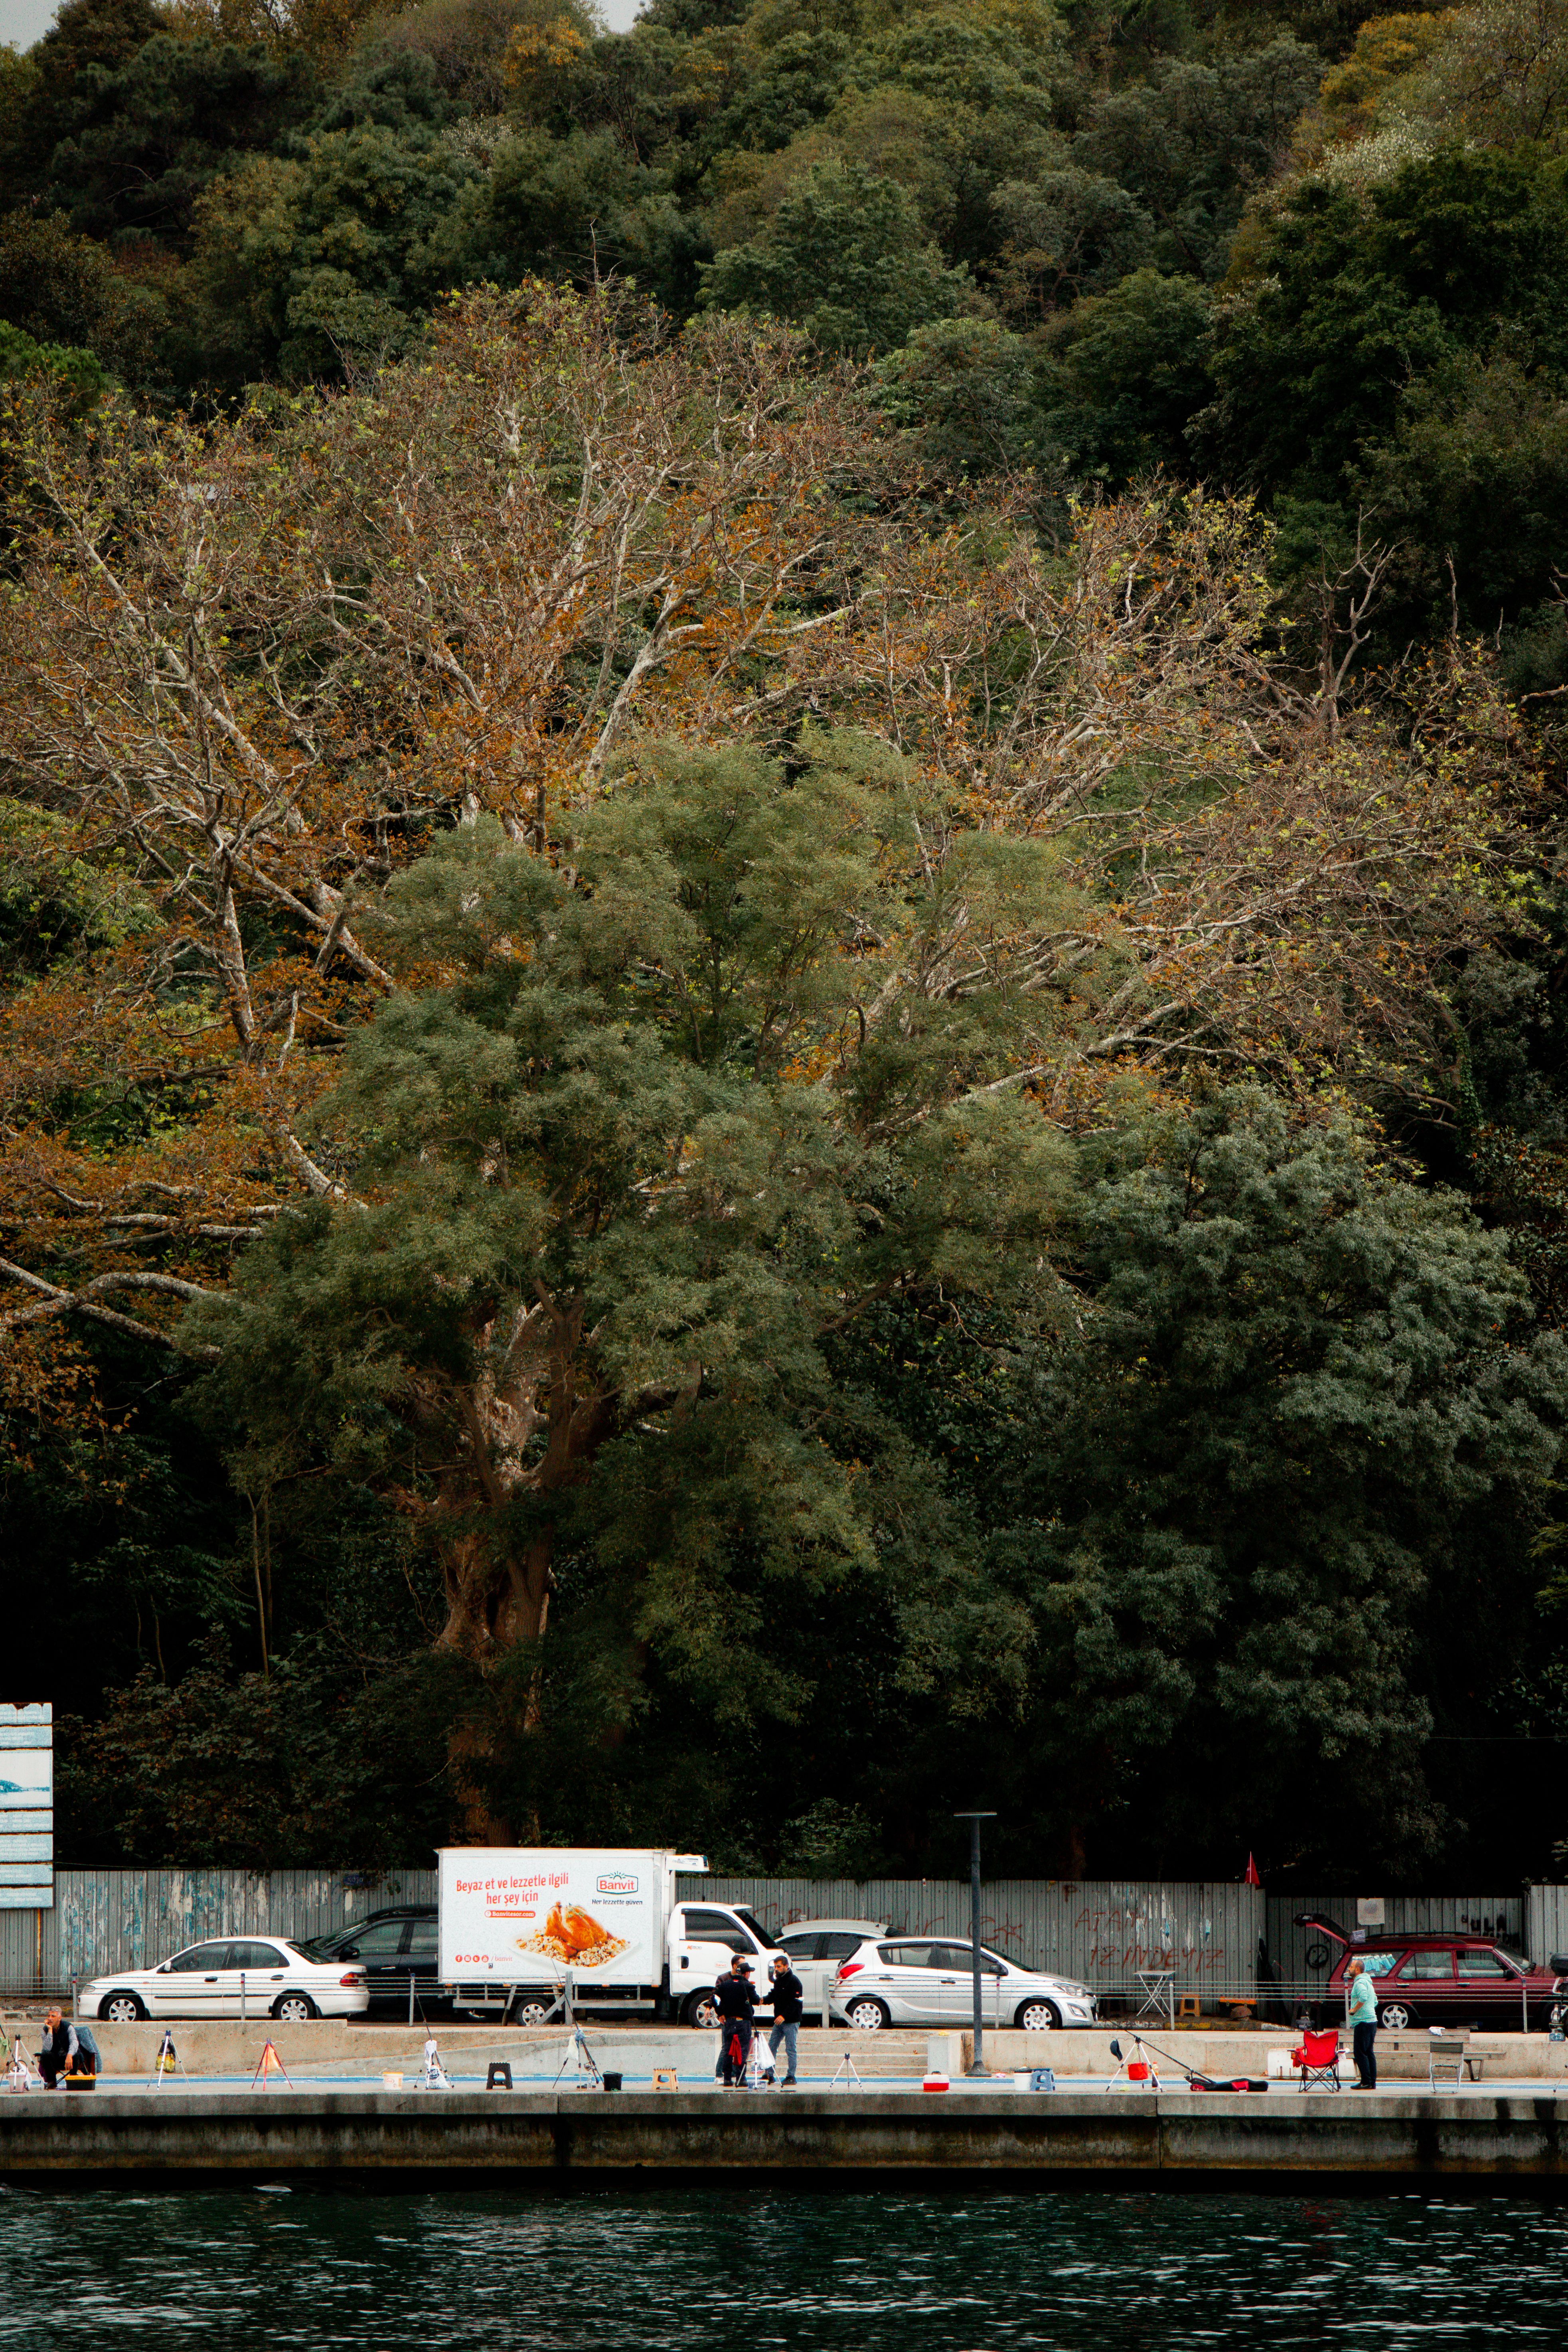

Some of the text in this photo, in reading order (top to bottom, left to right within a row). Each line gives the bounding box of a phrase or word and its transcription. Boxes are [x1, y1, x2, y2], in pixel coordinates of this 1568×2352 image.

[456, 1872, 569, 1894] Beyaz et ve lezzetle ilgili
[600, 1880, 635, 1890] Banvit
[486, 1890, 538, 1906] her şey için
